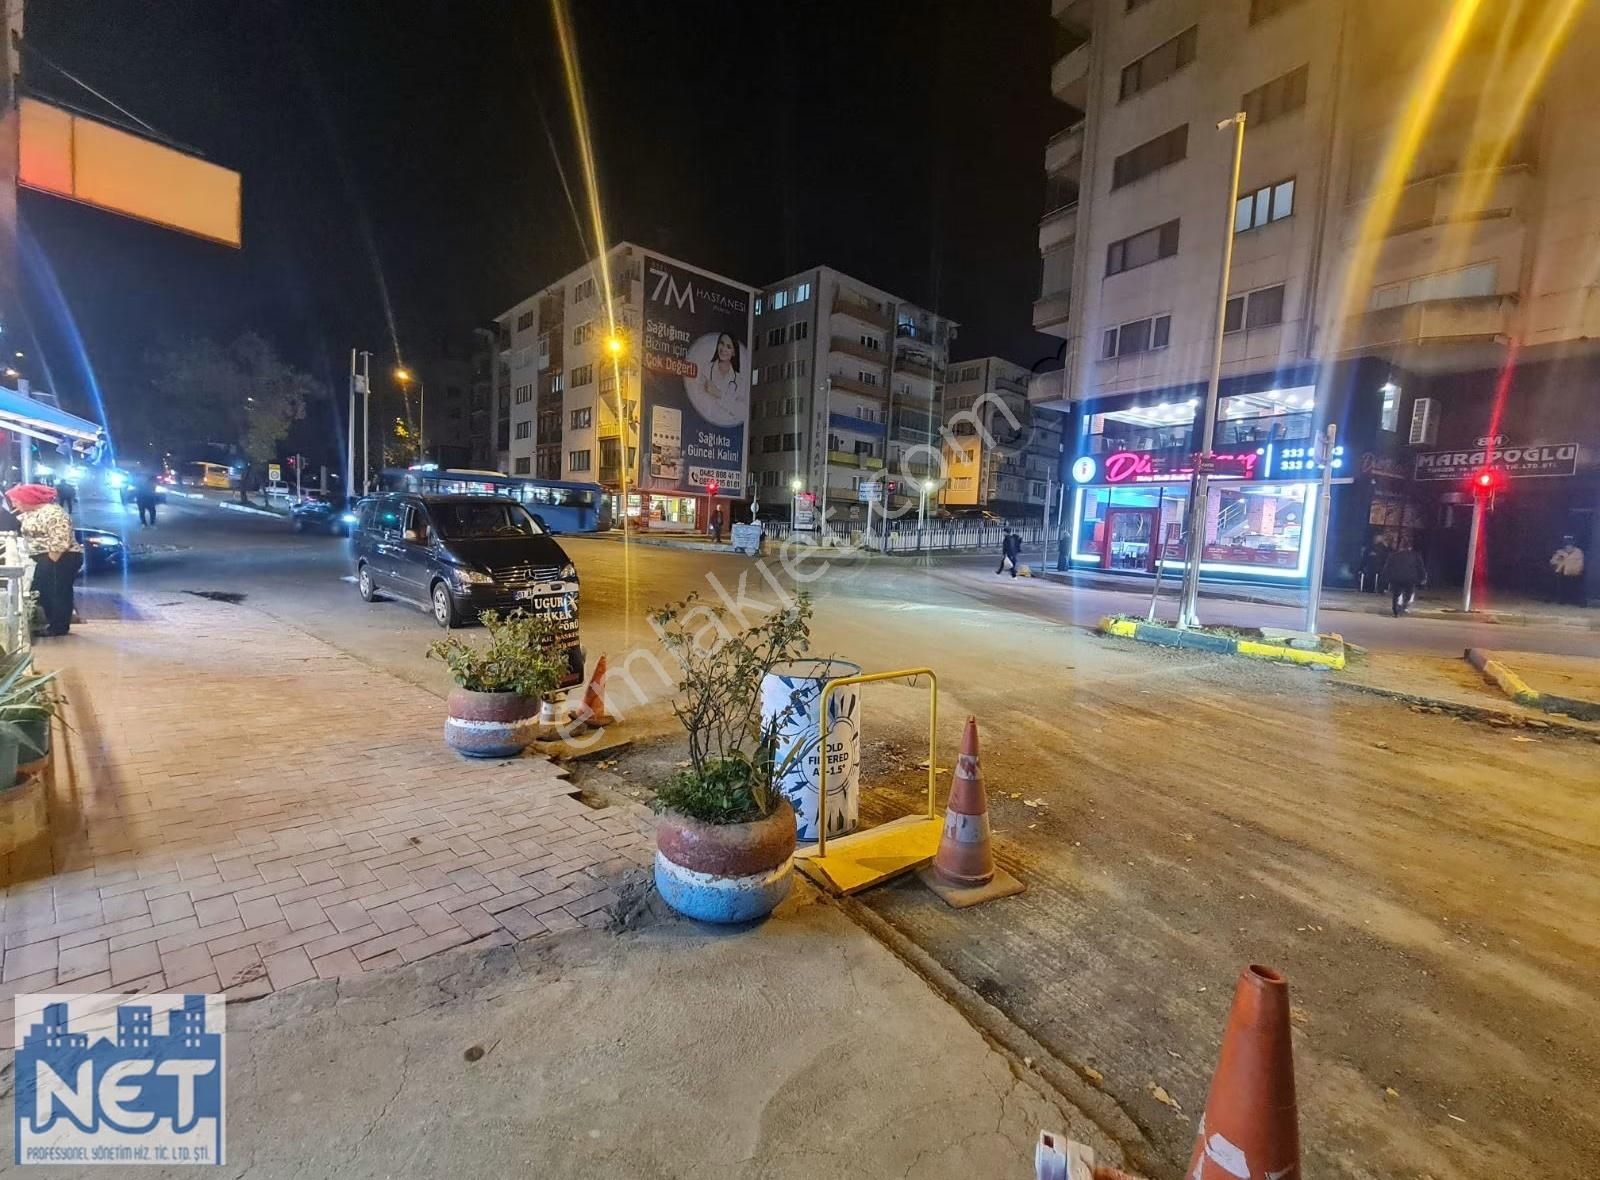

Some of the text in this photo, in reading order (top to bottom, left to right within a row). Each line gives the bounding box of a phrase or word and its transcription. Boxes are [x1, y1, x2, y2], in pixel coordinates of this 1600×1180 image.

[650, 268, 695, 313] 7M
[646, 319, 690, 343] Sağlığınız
[645, 335, 670, 353] Bizim
[645, 352, 696, 376] Çok Değerli
[698, 431, 731, 447] Sağlıkta
[687, 443, 715, 460] Güncel
[816, 742, 843, 753] OLD
